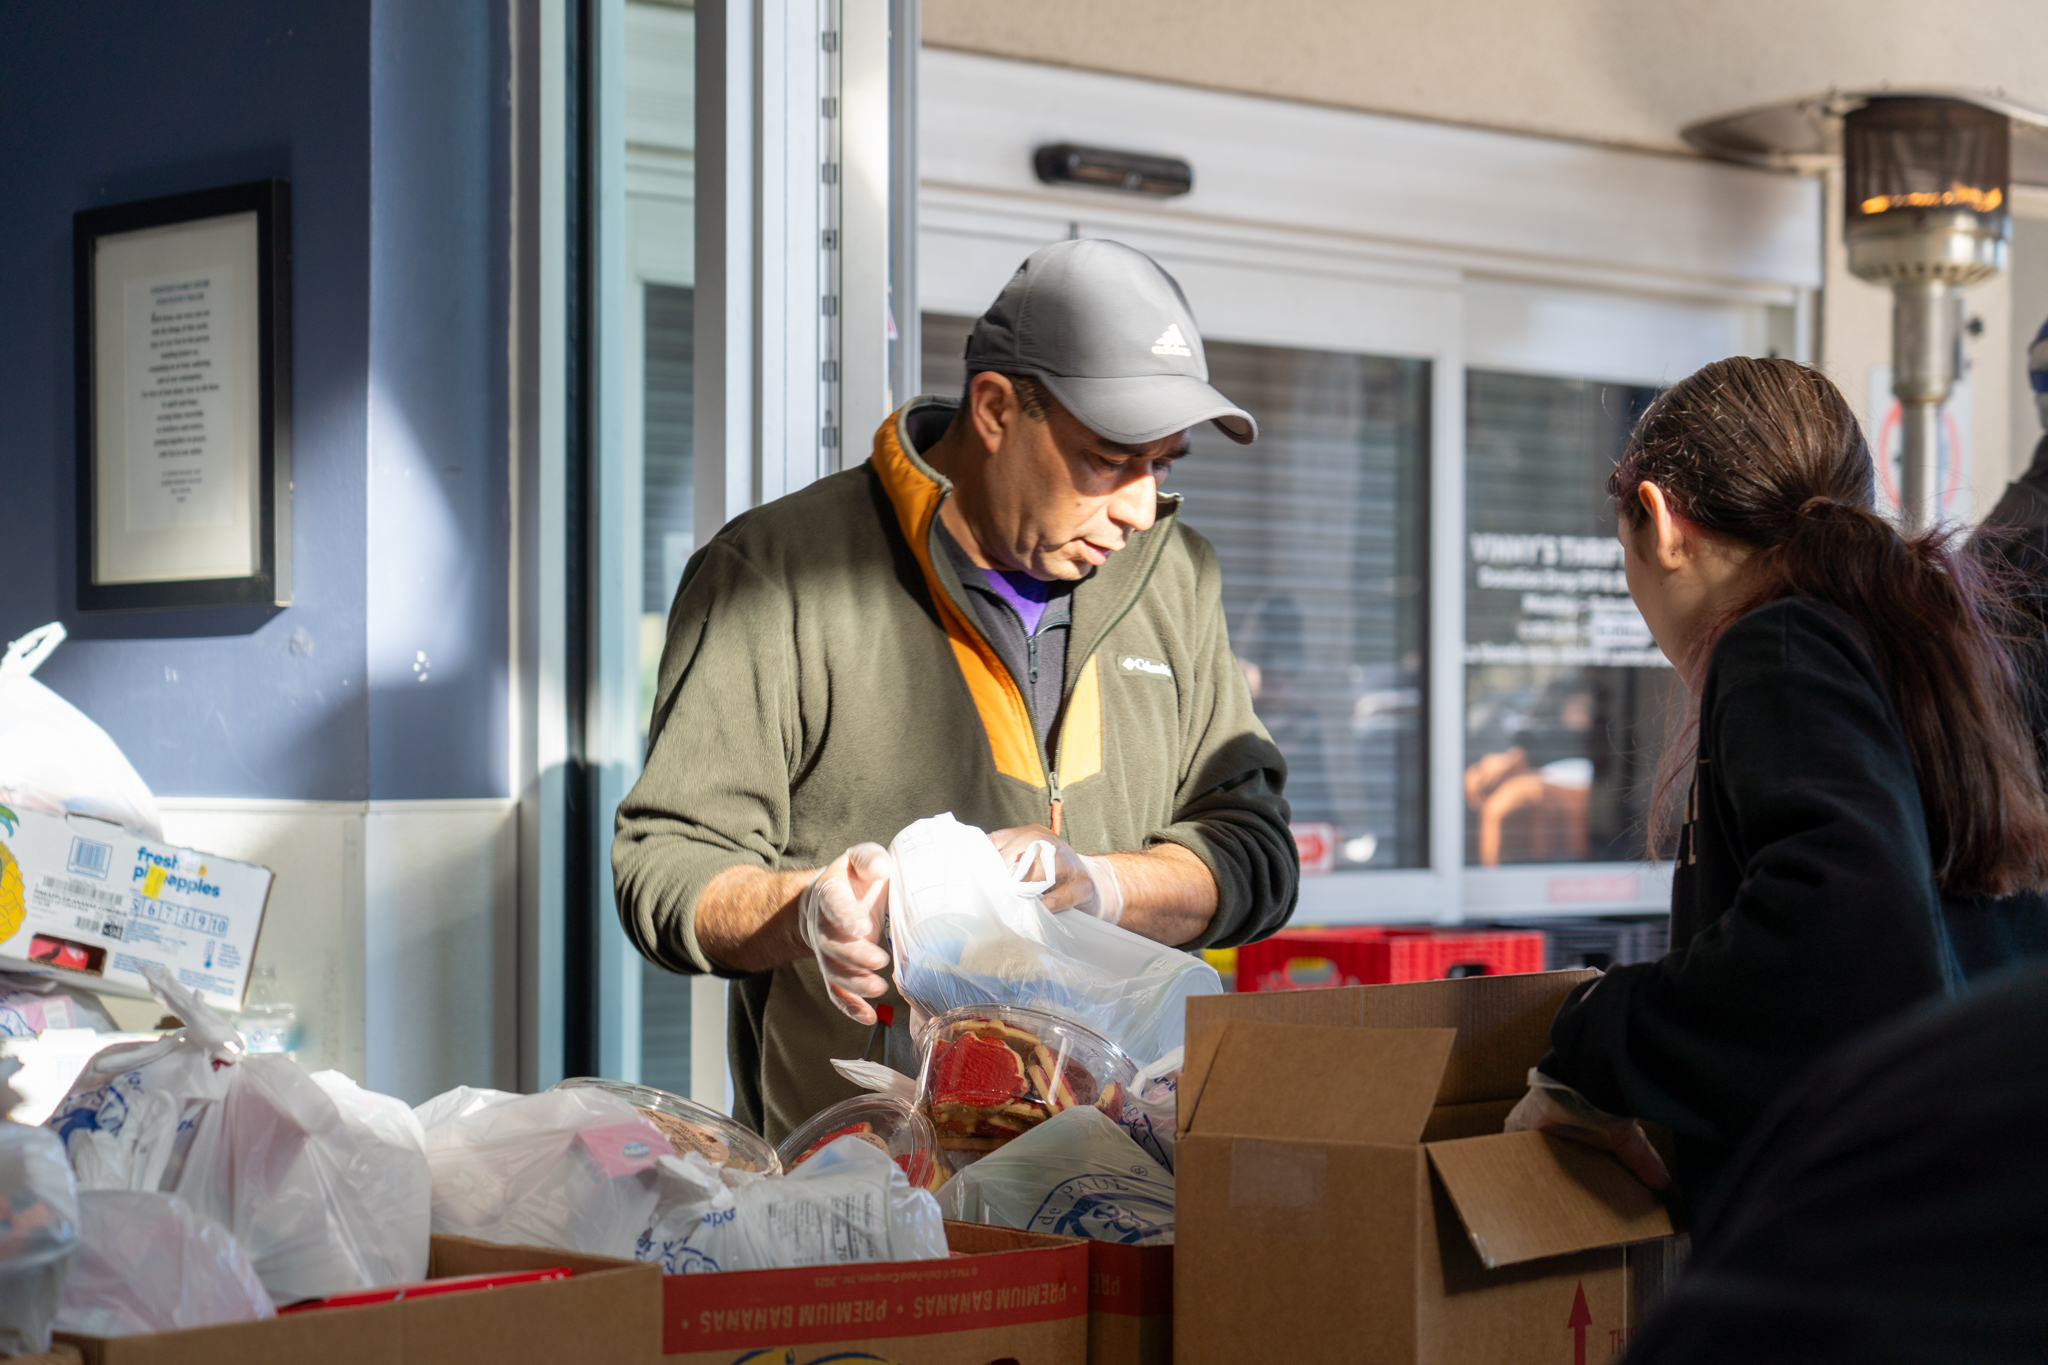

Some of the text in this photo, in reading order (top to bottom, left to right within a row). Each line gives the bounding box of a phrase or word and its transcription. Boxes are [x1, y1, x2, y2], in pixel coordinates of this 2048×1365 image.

[137, 846, 181, 872] fresh
[132, 863, 220, 898] piapples
[147, 902, 155, 916] 6
[198, 914, 206, 928] 9
[212, 918, 226, 933] 10
[1061, 1178, 1129, 1201] PAUL
[700, 1299, 887, 1334] PREMIUM BANANAS
[913, 1281, 1067, 1319] PREMIUM BANANAS
